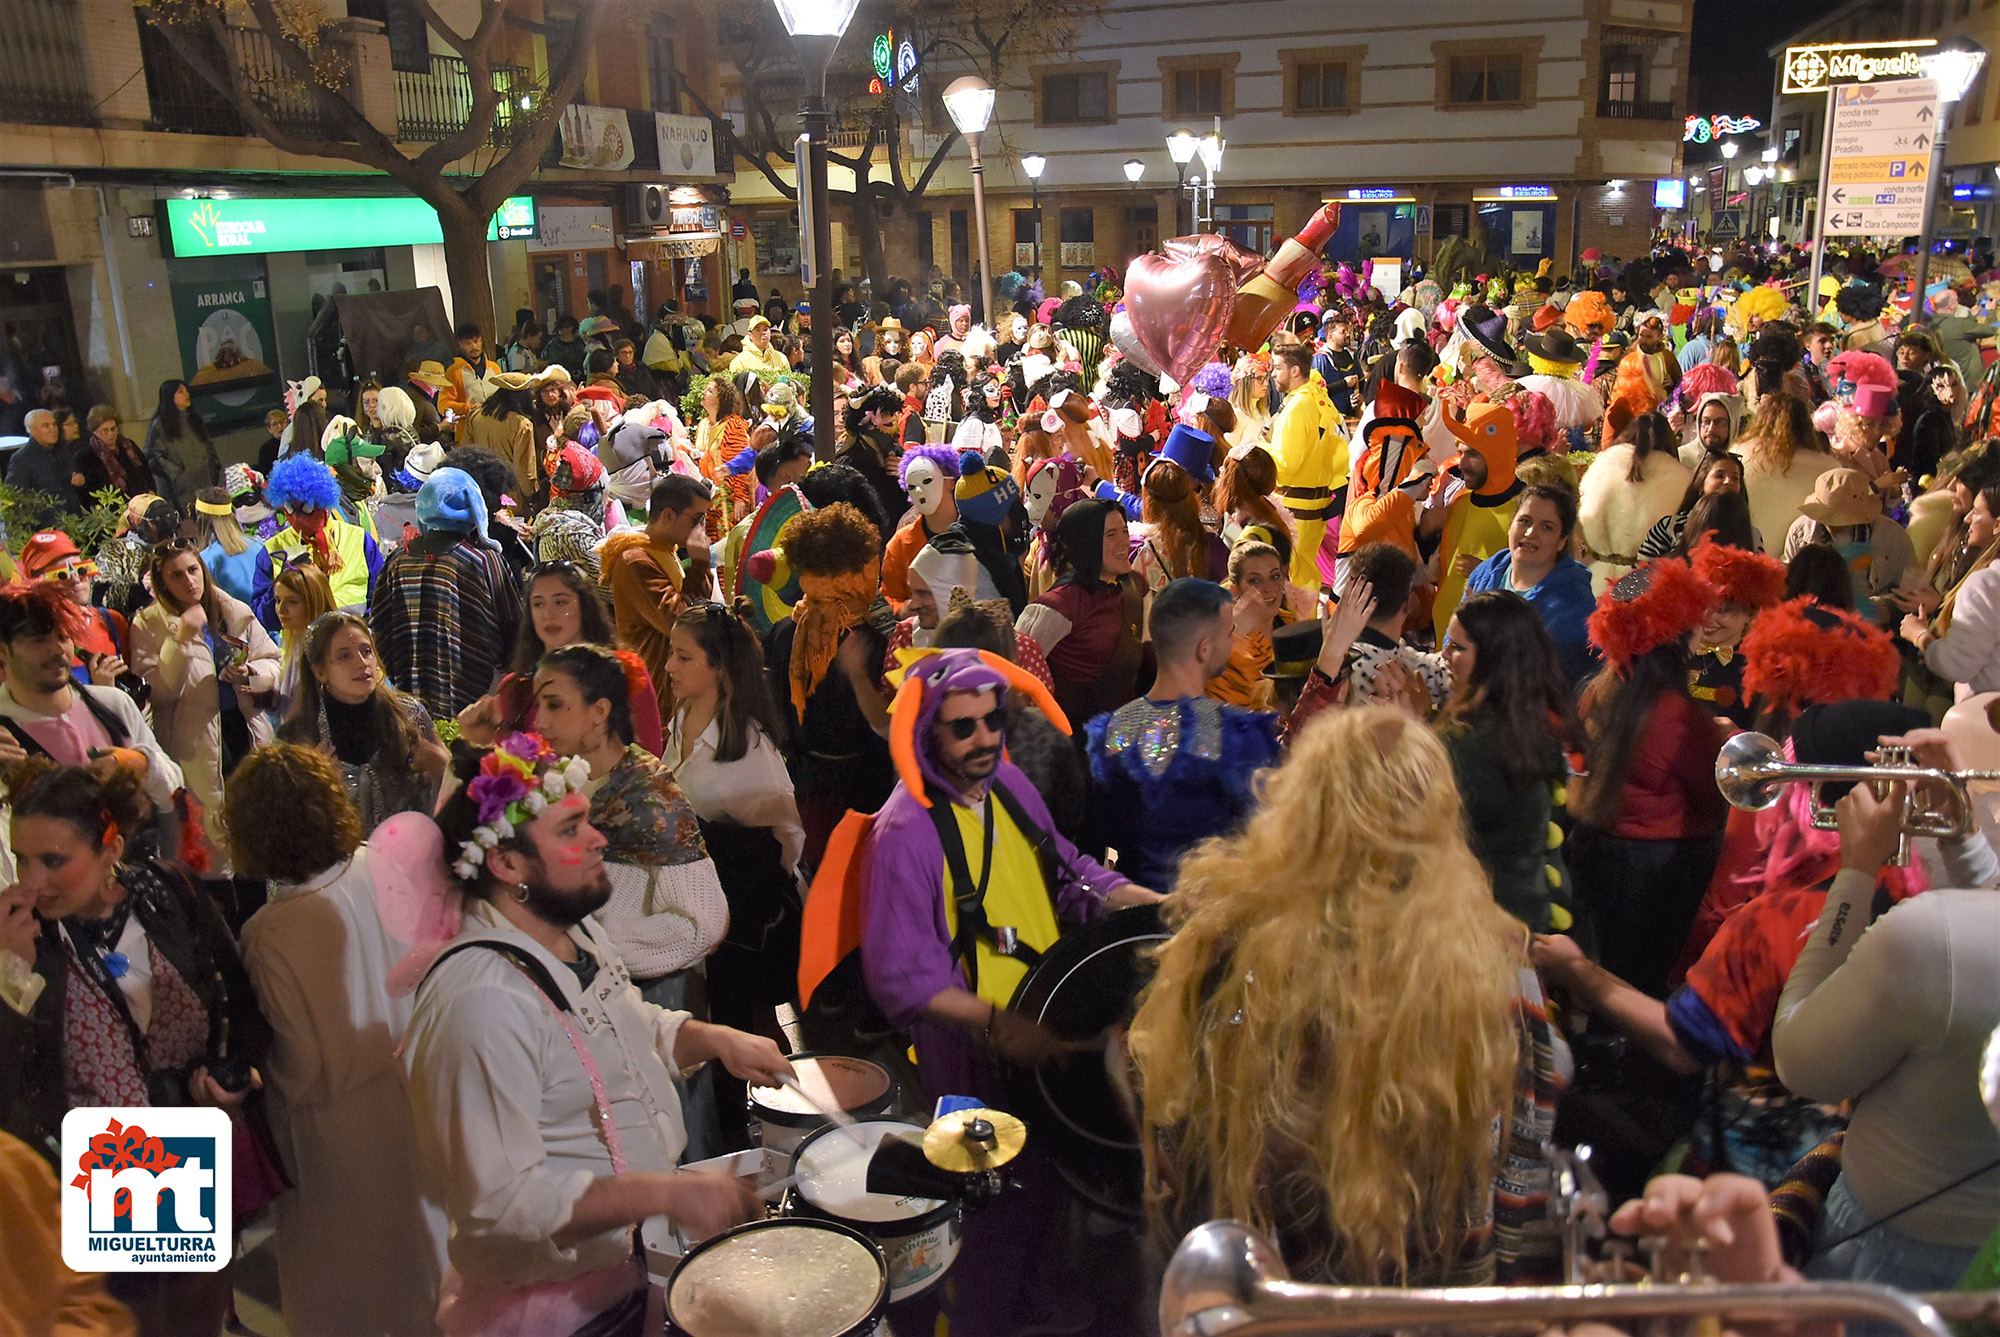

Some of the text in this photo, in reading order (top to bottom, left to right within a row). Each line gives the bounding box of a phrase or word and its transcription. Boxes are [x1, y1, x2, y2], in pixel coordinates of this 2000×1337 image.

[1838, 108, 1879, 117] ronda este
[1838, 119, 1872, 128] auditorio
[662, 125, 708, 143] NARANJO
[1835, 136, 1858, 145] colegio
[1834, 145, 1863, 154] Pradillo
[1832, 161, 1890, 170] mercado municipal
[1891, 162, 1903, 176] P
[1884, 185, 1925, 194] ronda norte
[1876, 195, 1895, 203] A-43
[1897, 212, 1921, 220] colegio
[1864, 220, 1919, 229] Clara Campoamor
[197, 291, 246, 307] ARRANCA
[199, 321, 258, 366] PAC
